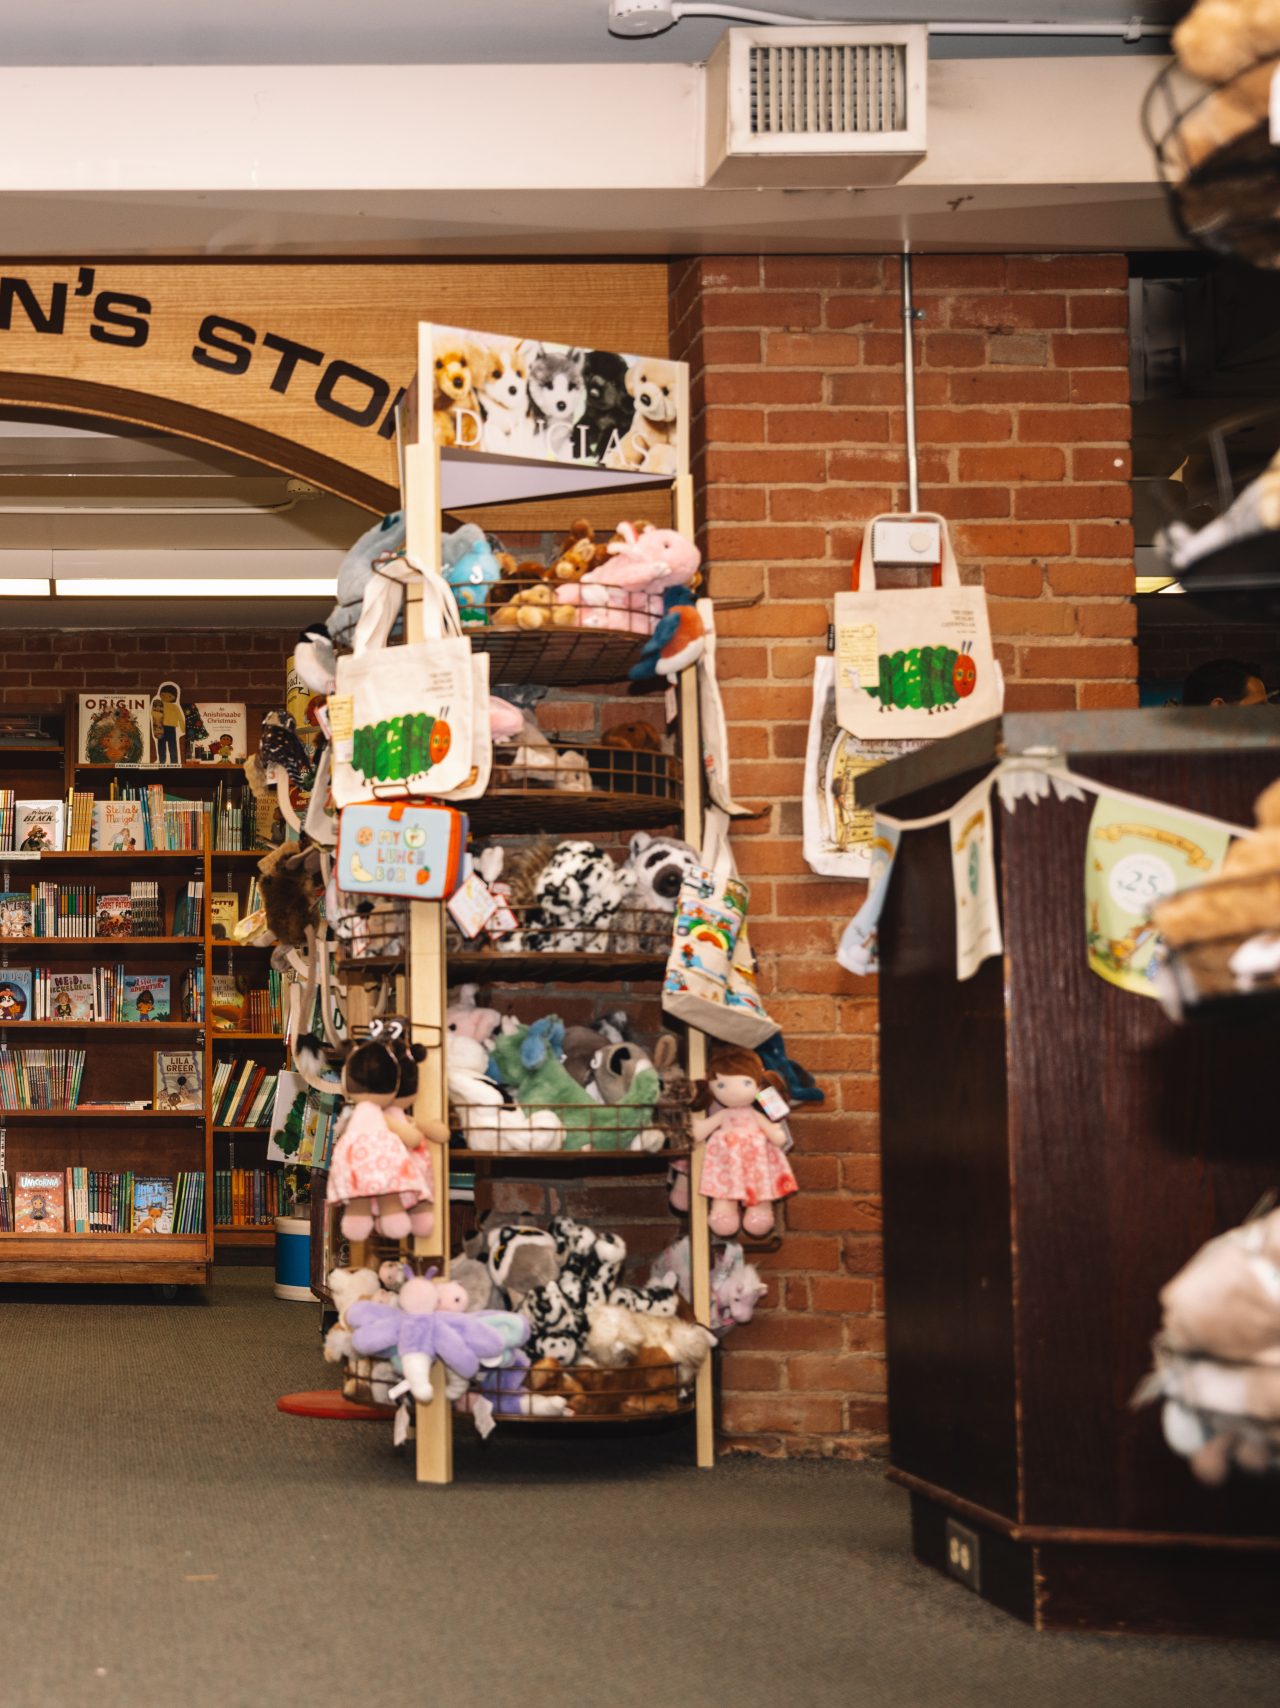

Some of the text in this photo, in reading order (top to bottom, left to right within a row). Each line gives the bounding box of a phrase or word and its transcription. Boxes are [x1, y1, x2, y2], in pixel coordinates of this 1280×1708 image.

[453, 407, 651, 470] DGLAS
[85, 699, 145, 710] ORIGIN
[378, 830, 400, 845] MY
[376, 848, 425, 864] LUNCH
[170, 1057, 190, 1065] LILA
